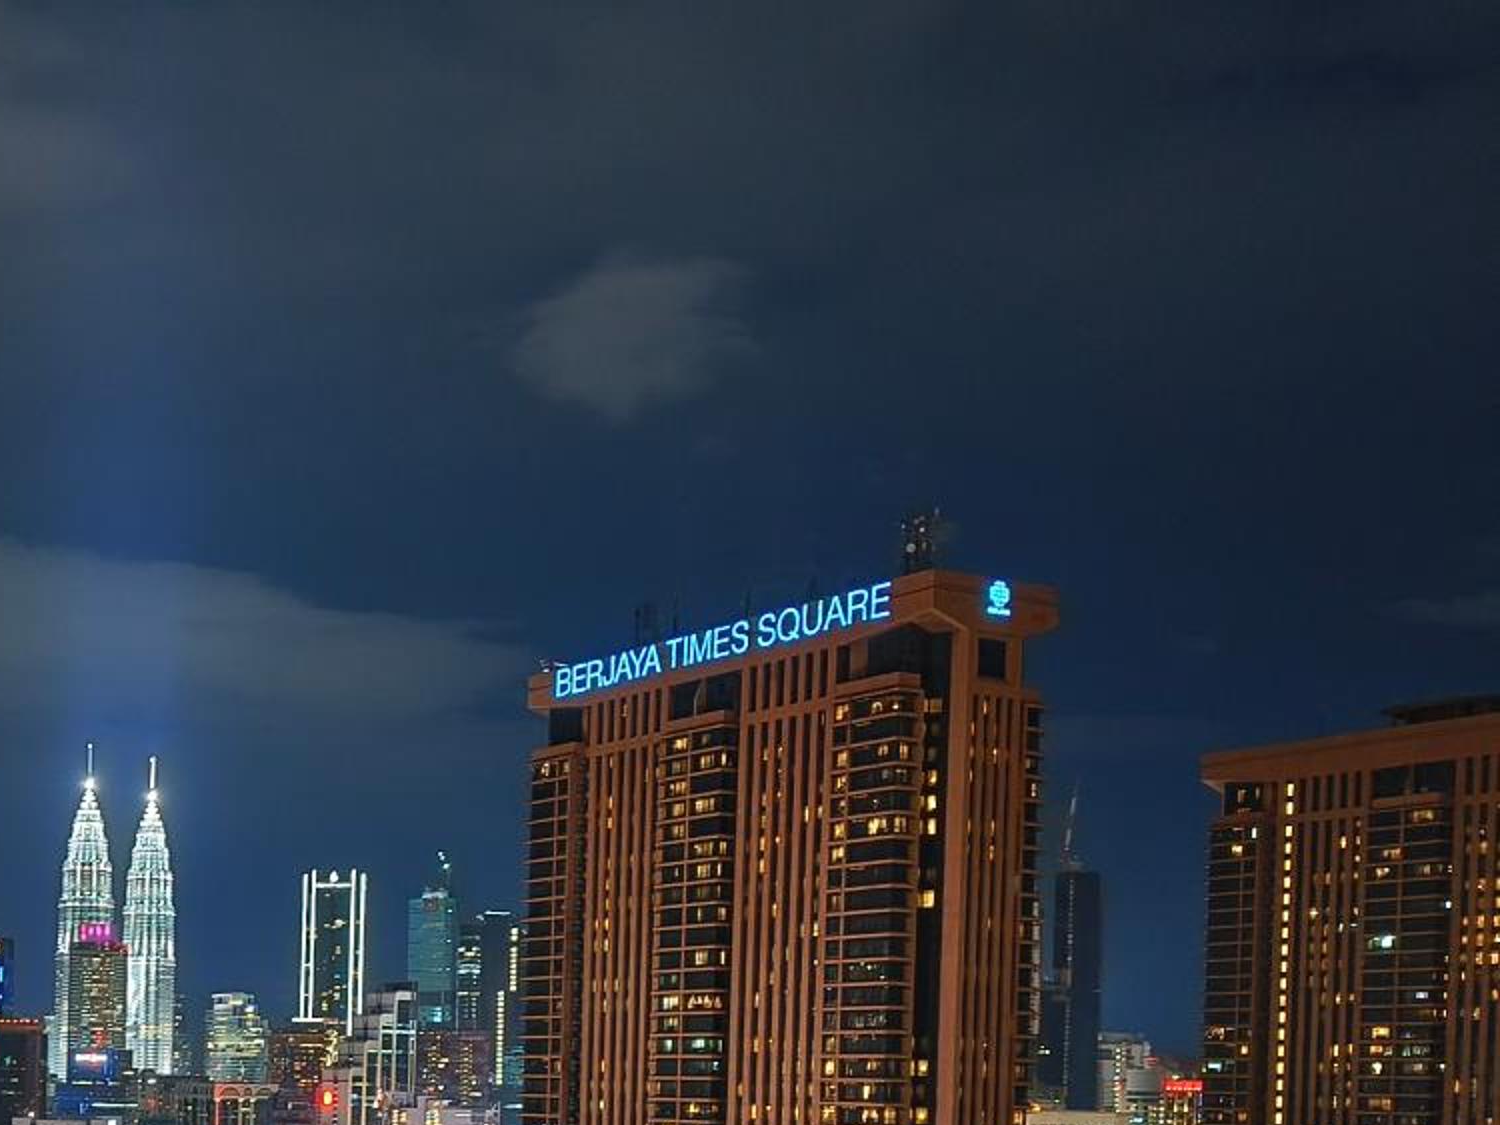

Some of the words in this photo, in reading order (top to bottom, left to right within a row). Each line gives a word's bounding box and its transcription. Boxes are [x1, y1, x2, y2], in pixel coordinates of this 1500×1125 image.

[555, 644, 662, 699] BERJAYA
[666, 620, 749, 669] TIMES
[757, 581, 892, 648] SQUARE
